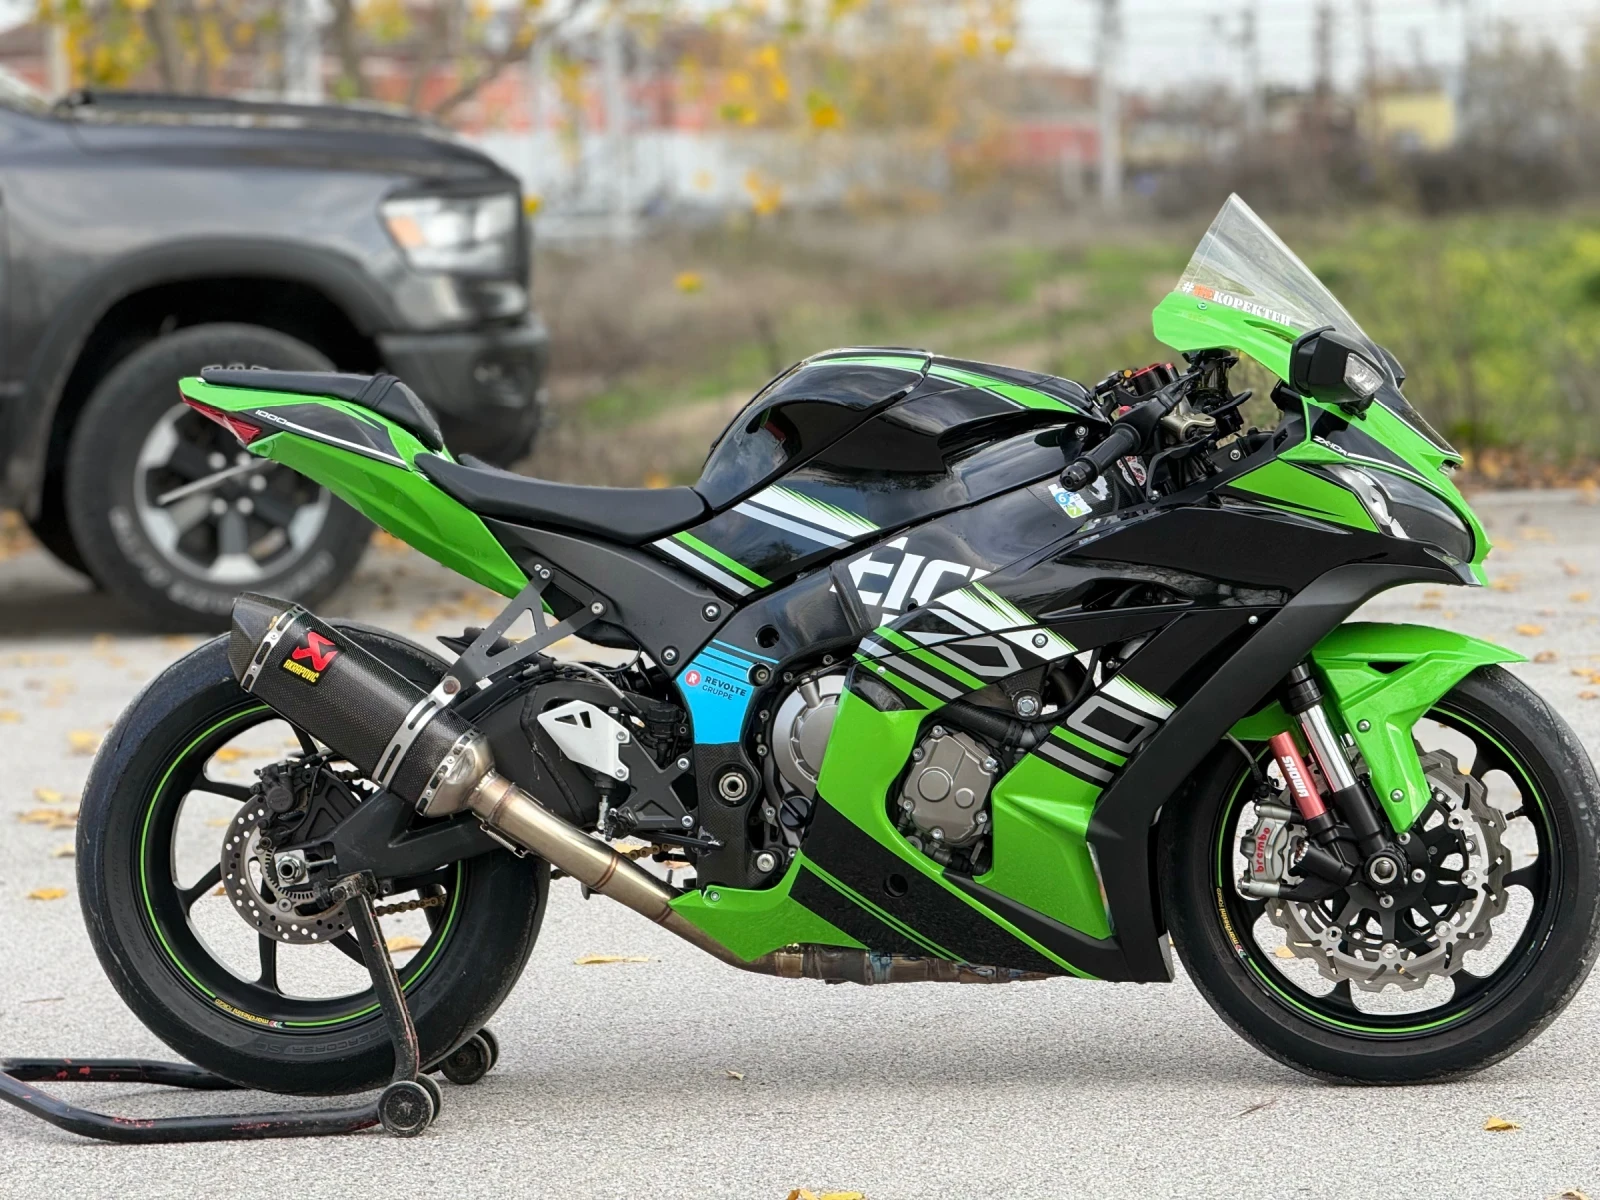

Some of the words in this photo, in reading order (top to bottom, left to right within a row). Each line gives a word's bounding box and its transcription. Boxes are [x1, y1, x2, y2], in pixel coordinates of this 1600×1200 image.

[255, 409, 287, 425] 1000
[1313, 435, 1348, 456] ZX-10R
[702, 684, 734, 701] GRUPPE
[704, 675, 747, 697] REVOLTE
[1281, 755, 1310, 798] SHOWA
[1255, 827, 1270, 873] brembo
